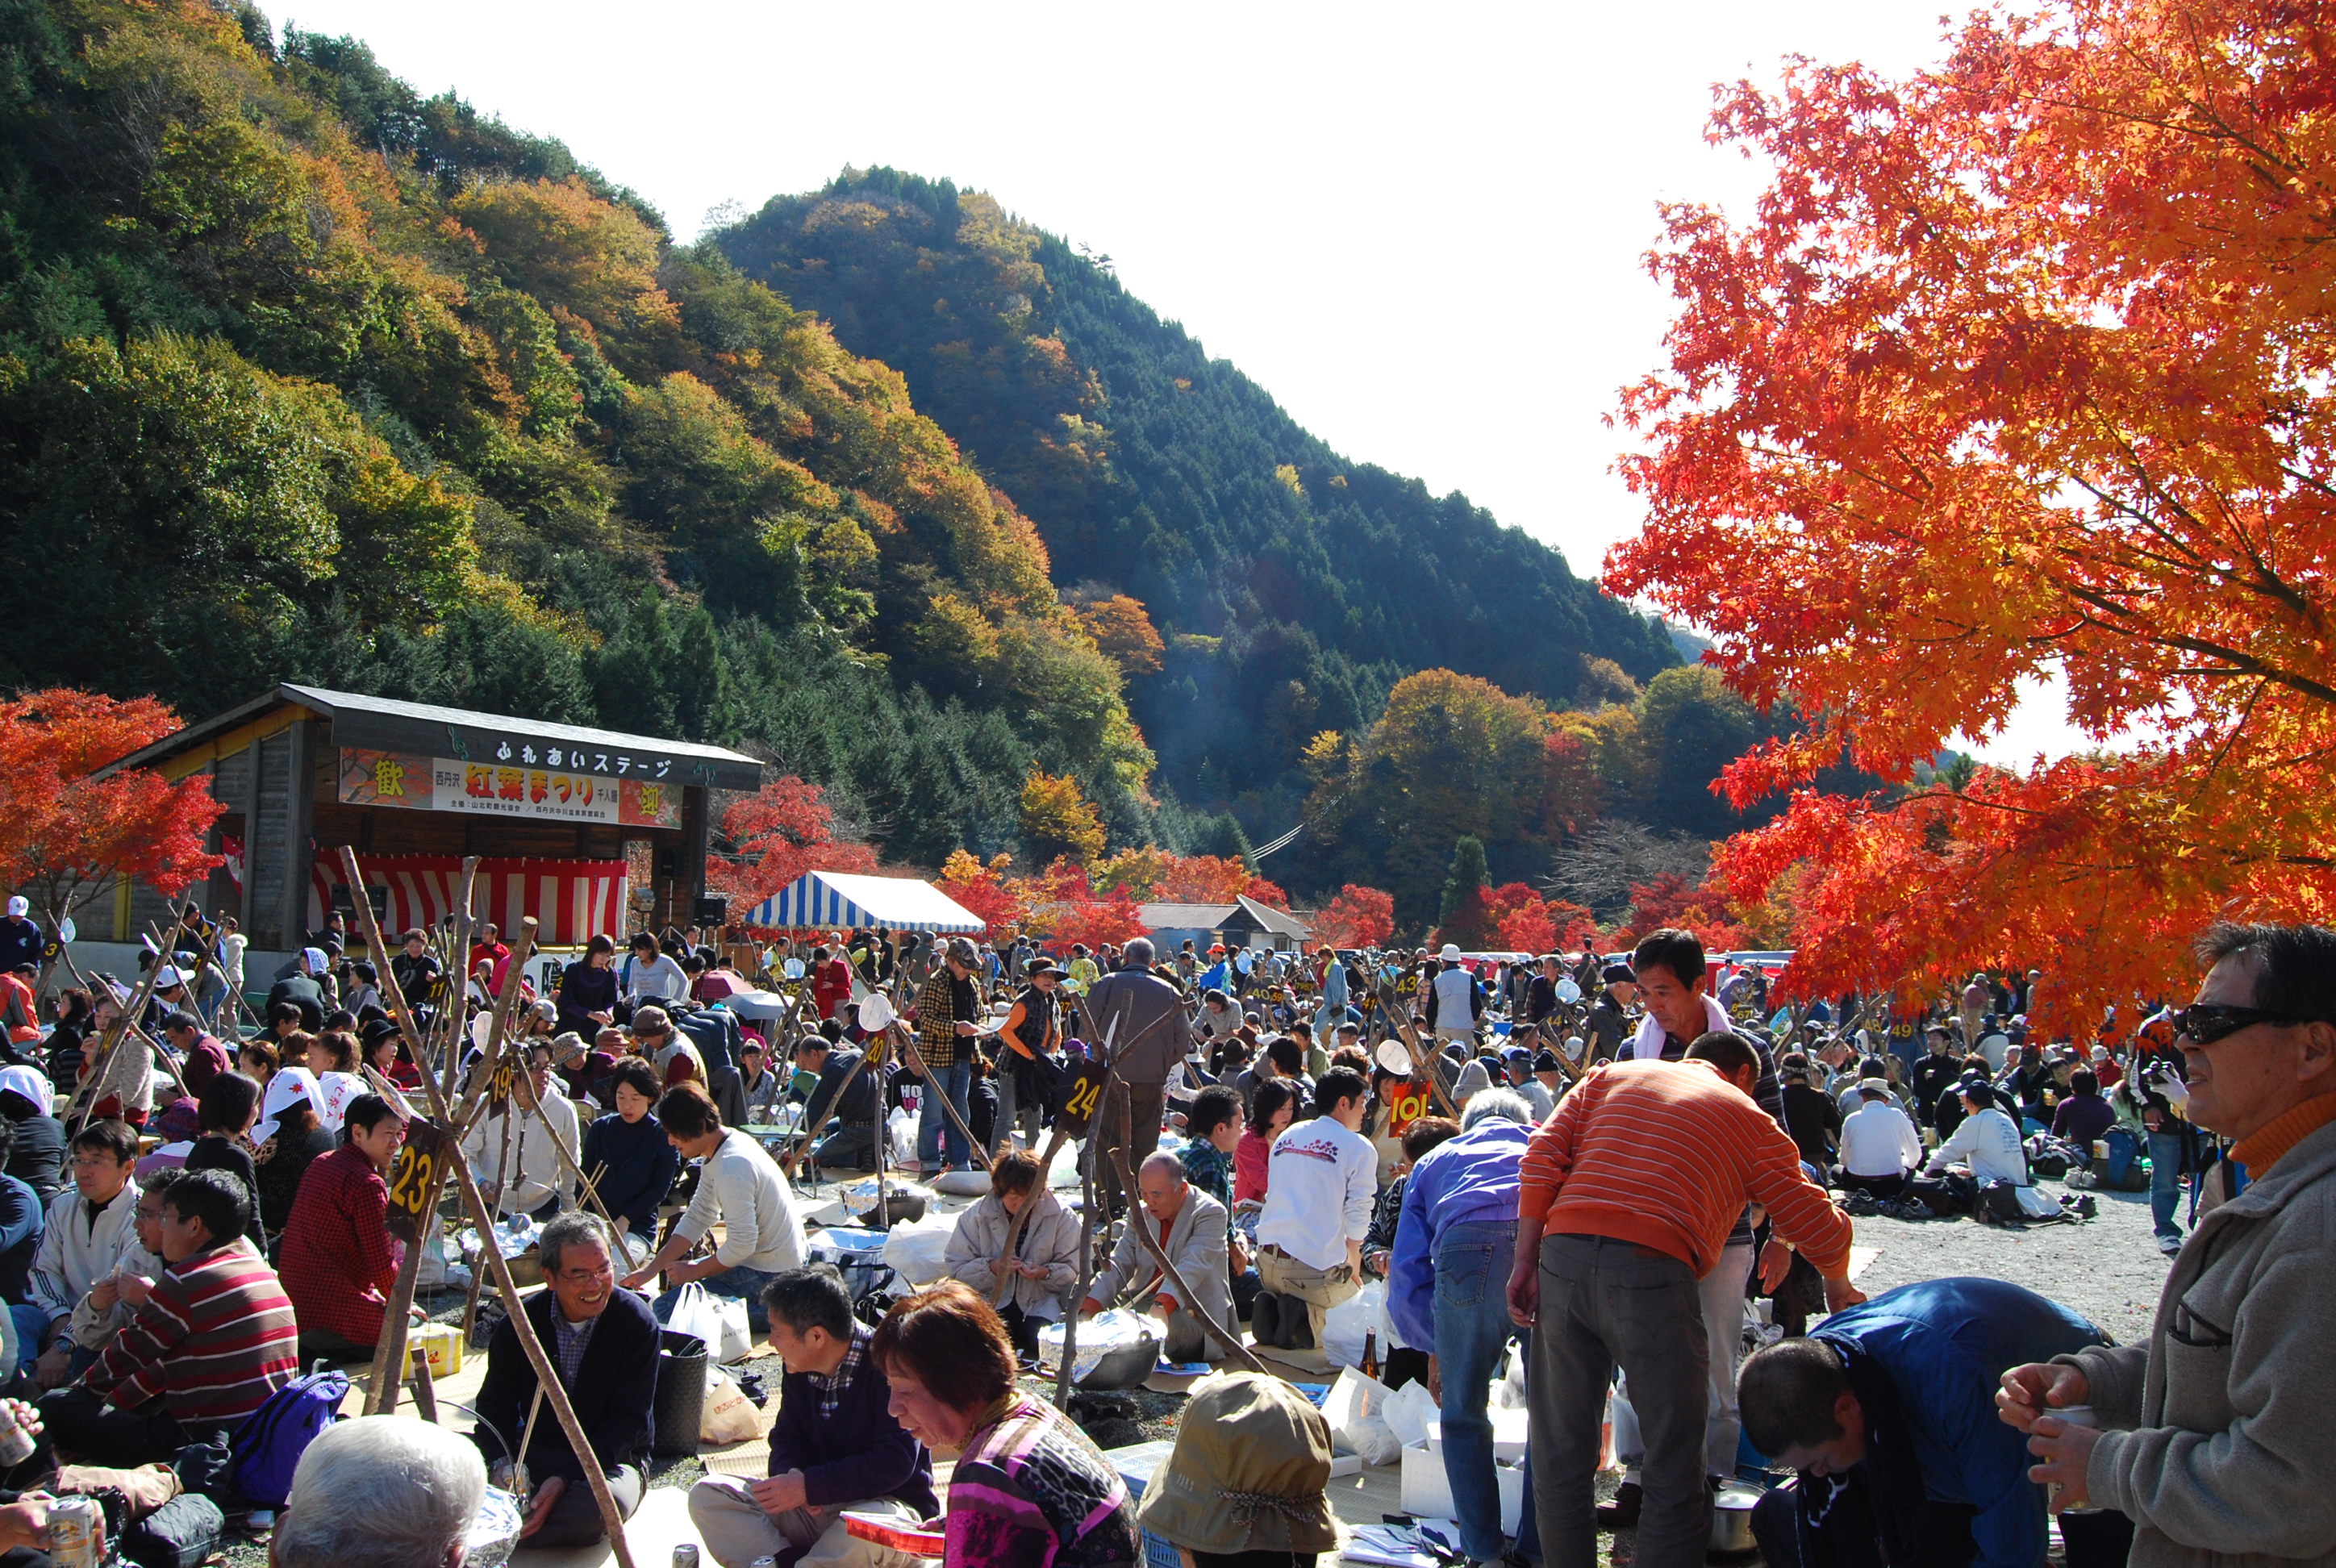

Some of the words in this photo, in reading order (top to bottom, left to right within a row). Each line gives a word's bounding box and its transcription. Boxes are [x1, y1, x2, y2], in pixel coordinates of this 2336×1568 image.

[497, 741, 672, 778] ふれあいステージ
[375, 760, 404, 797] 歓
[436, 771, 460, 788] 西丹沢
[465, 763, 594, 807] 紅葉まつり
[640, 786, 659, 816] 迎
[45, 943, 57, 957] 3
[430, 982, 444, 998] 11
[783, 982, 801, 995] 35
[1252, 988, 1270, 999] 40
[1396, 976, 1416, 994] 43
[1272, 993, 1283, 1002] 59
[1363, 998, 1377, 1010] 41
[1737, 1010, 1750, 1020] 67
[1865, 1019, 1881, 1033] 48
[1892, 1024, 1913, 1038] 49
[867, 1036, 884, 1063] 20
[493, 1065, 511, 1102] 19
[900, 1084, 924, 1099] HO
[1066, 1077, 1100, 1121] 24
[1391, 1094, 1428, 1123] 101
[391, 1146, 432, 1213] 23
